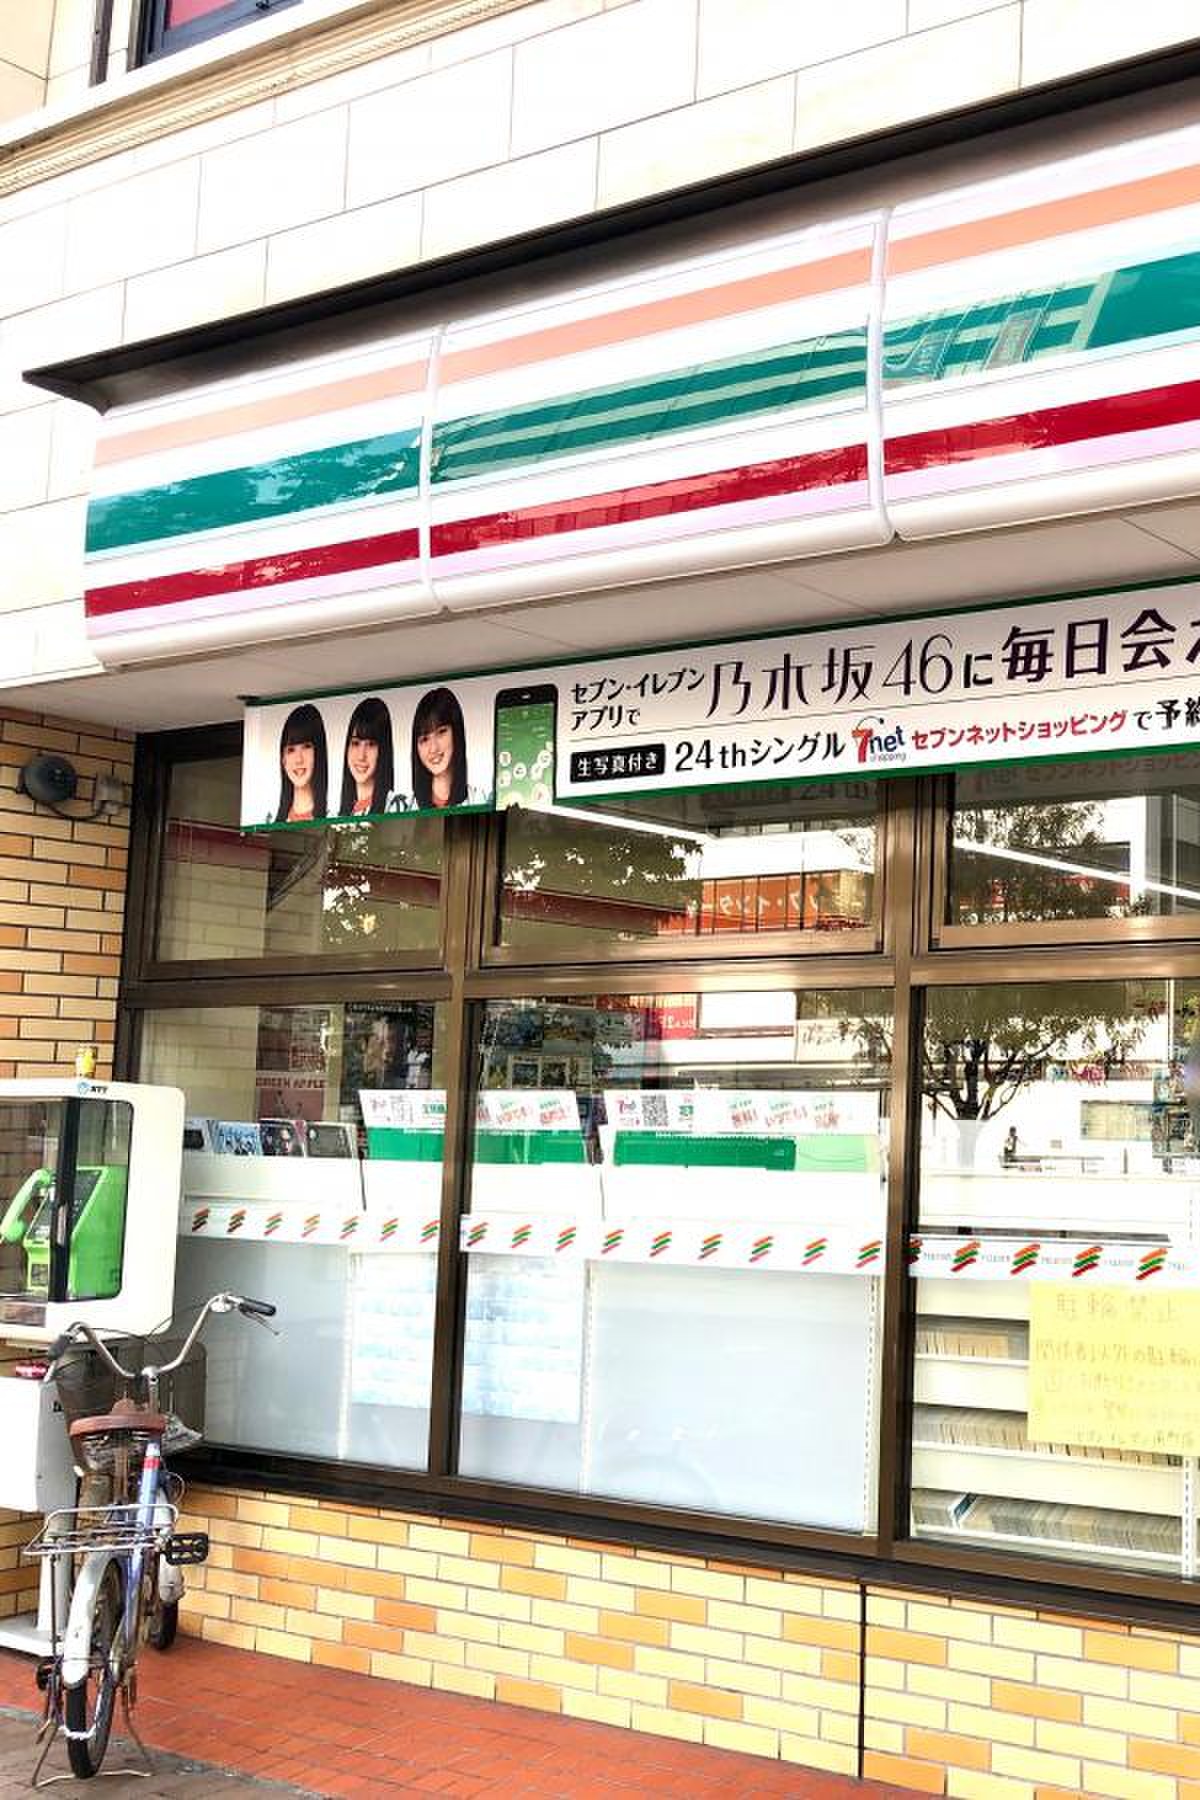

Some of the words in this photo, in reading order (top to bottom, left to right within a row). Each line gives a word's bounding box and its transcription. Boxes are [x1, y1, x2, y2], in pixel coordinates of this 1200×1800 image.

[571, 704, 641, 731] アプリで
[577, 752, 659, 777] 生写真付き
